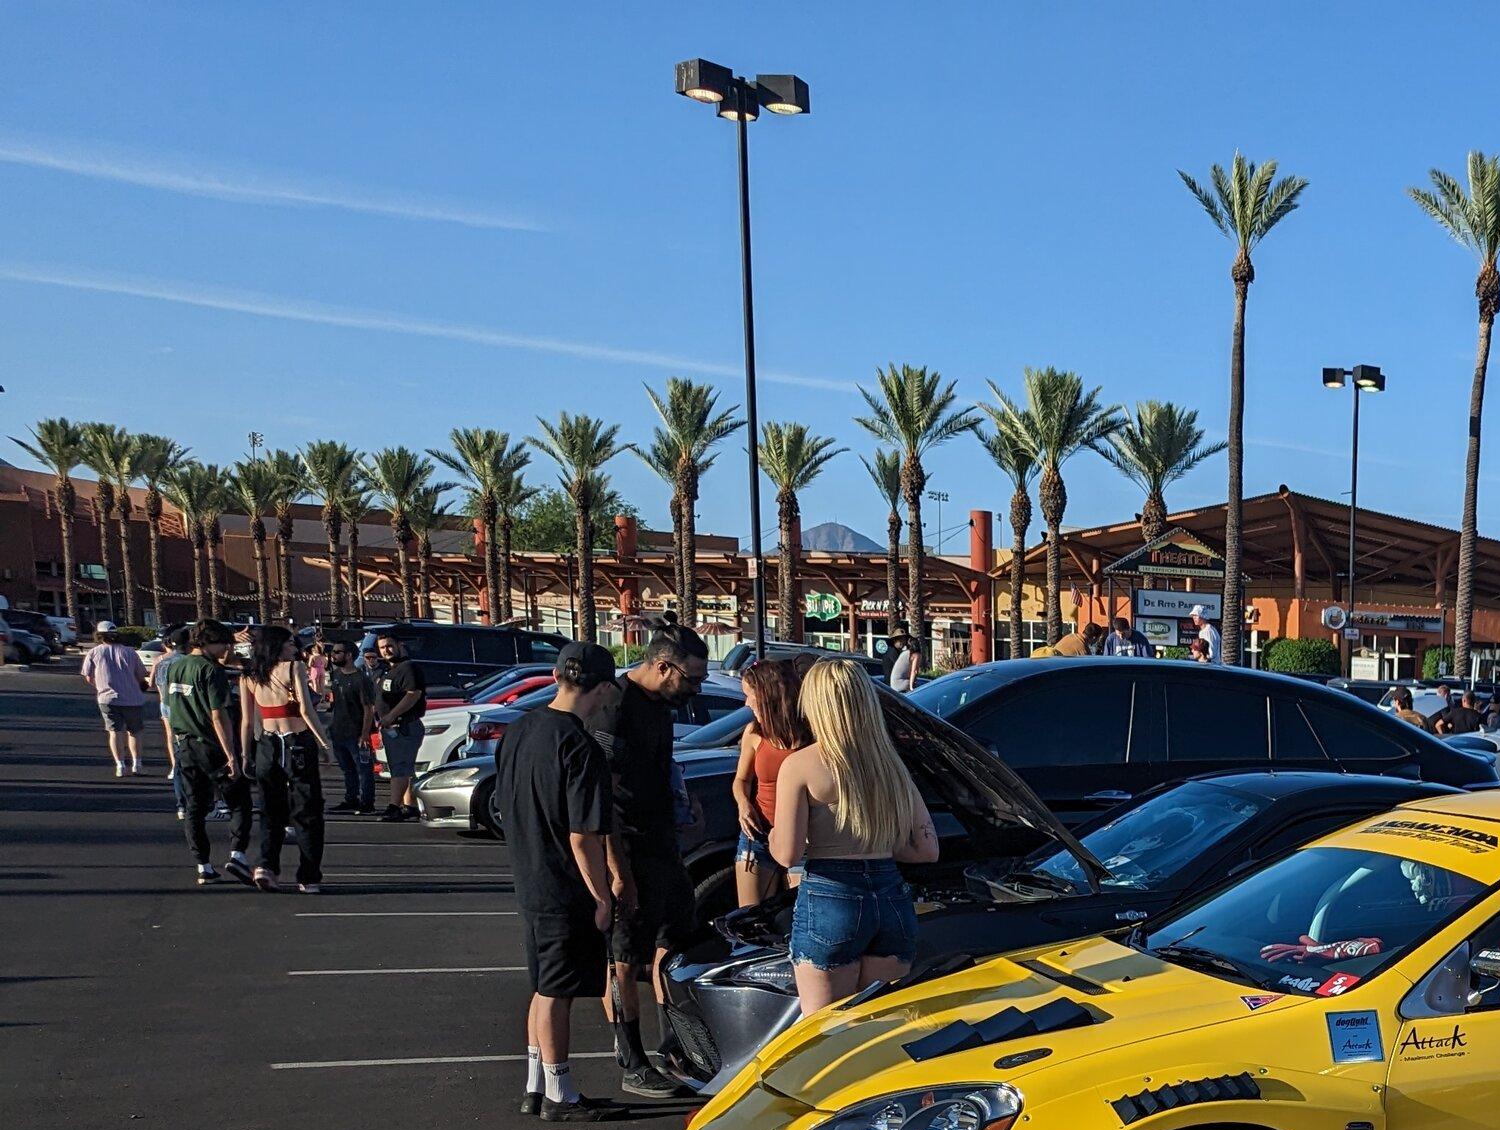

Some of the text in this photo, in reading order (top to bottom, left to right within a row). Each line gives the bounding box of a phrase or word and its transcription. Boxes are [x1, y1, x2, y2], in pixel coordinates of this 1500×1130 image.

[1399, 1024, 1468, 1055] Attack
[1403, 1051, 1466, 1062] Maximum Challenge
